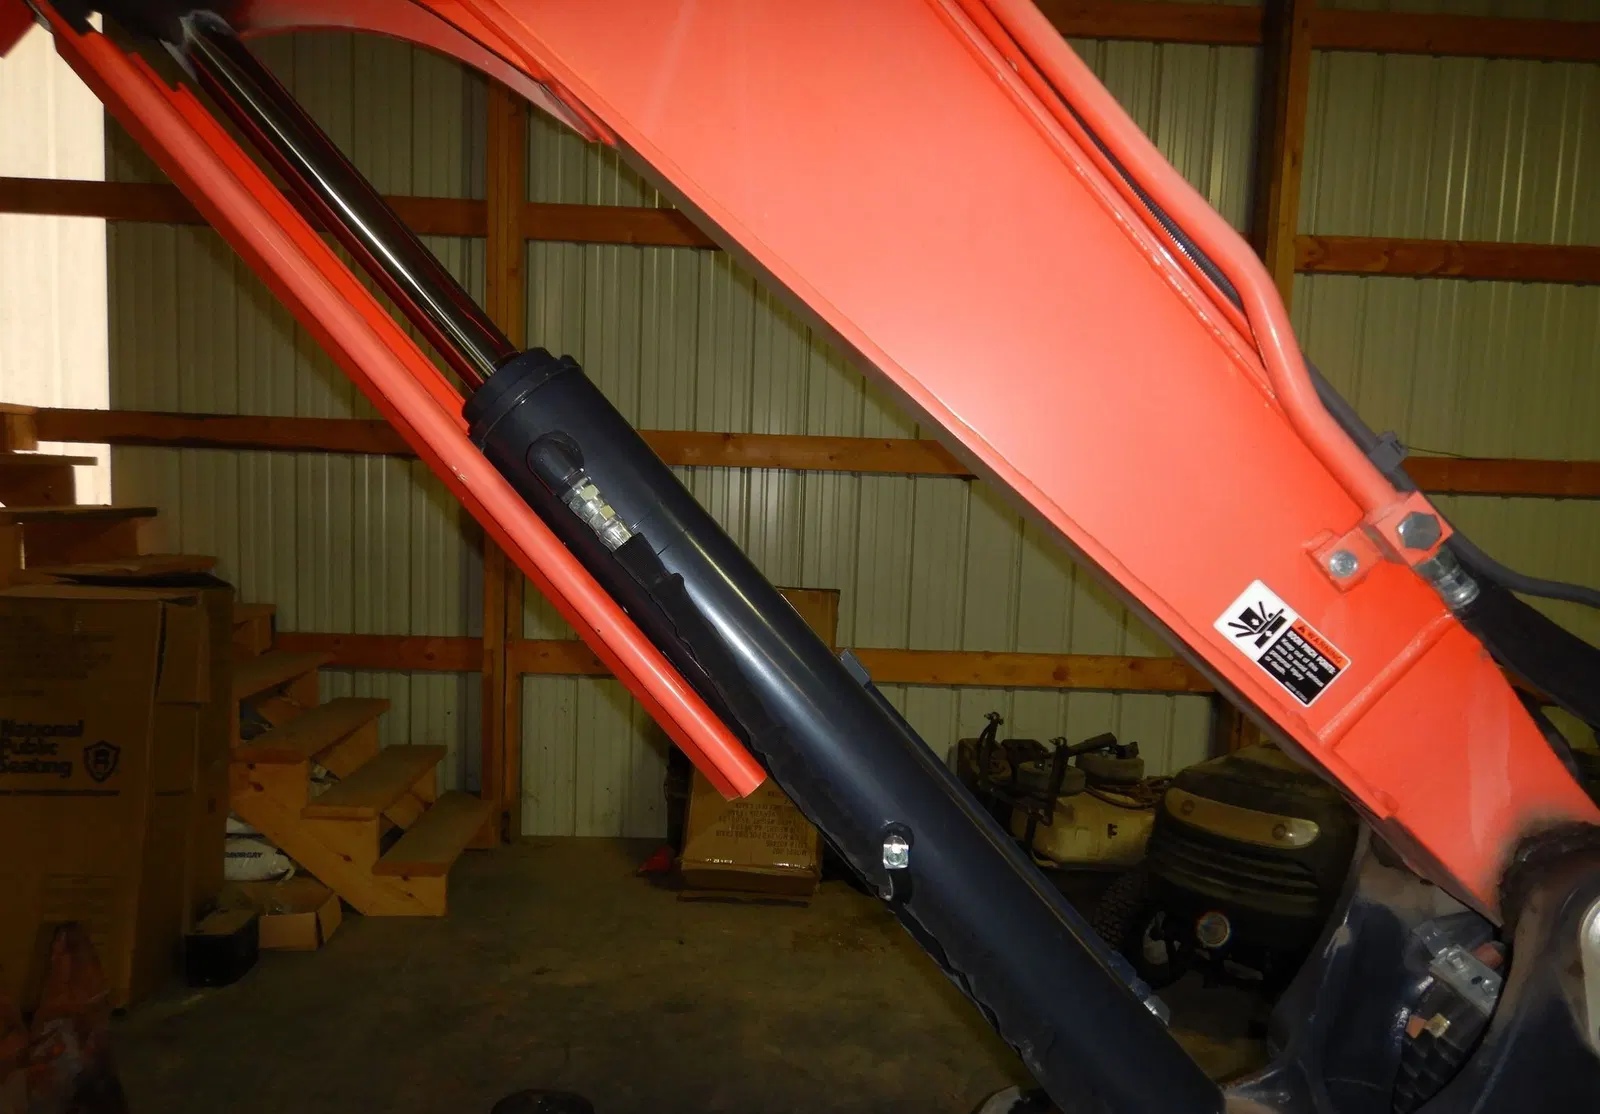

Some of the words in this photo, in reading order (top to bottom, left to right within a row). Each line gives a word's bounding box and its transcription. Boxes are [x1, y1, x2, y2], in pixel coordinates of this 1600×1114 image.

[1281, 638, 1295, 652] Keep
[1294, 650, 1304, 659] out
[1302, 656, 1310, 664] of
[1308, 661, 1319, 672] this
[1301, 643, 1318, 659] PINCH
[1307, 631, 1342, 664] WARNING
[1270, 650, 1292, 669] personal
[1290, 667, 1305, 681] injury
[1275, 644, 1288, 656] area
[1292, 659, 1308, 673] avoid
[1306, 671, 1324, 688] serious
[2, 719, 84, 737] National
[0, 738, 58, 755] Public
